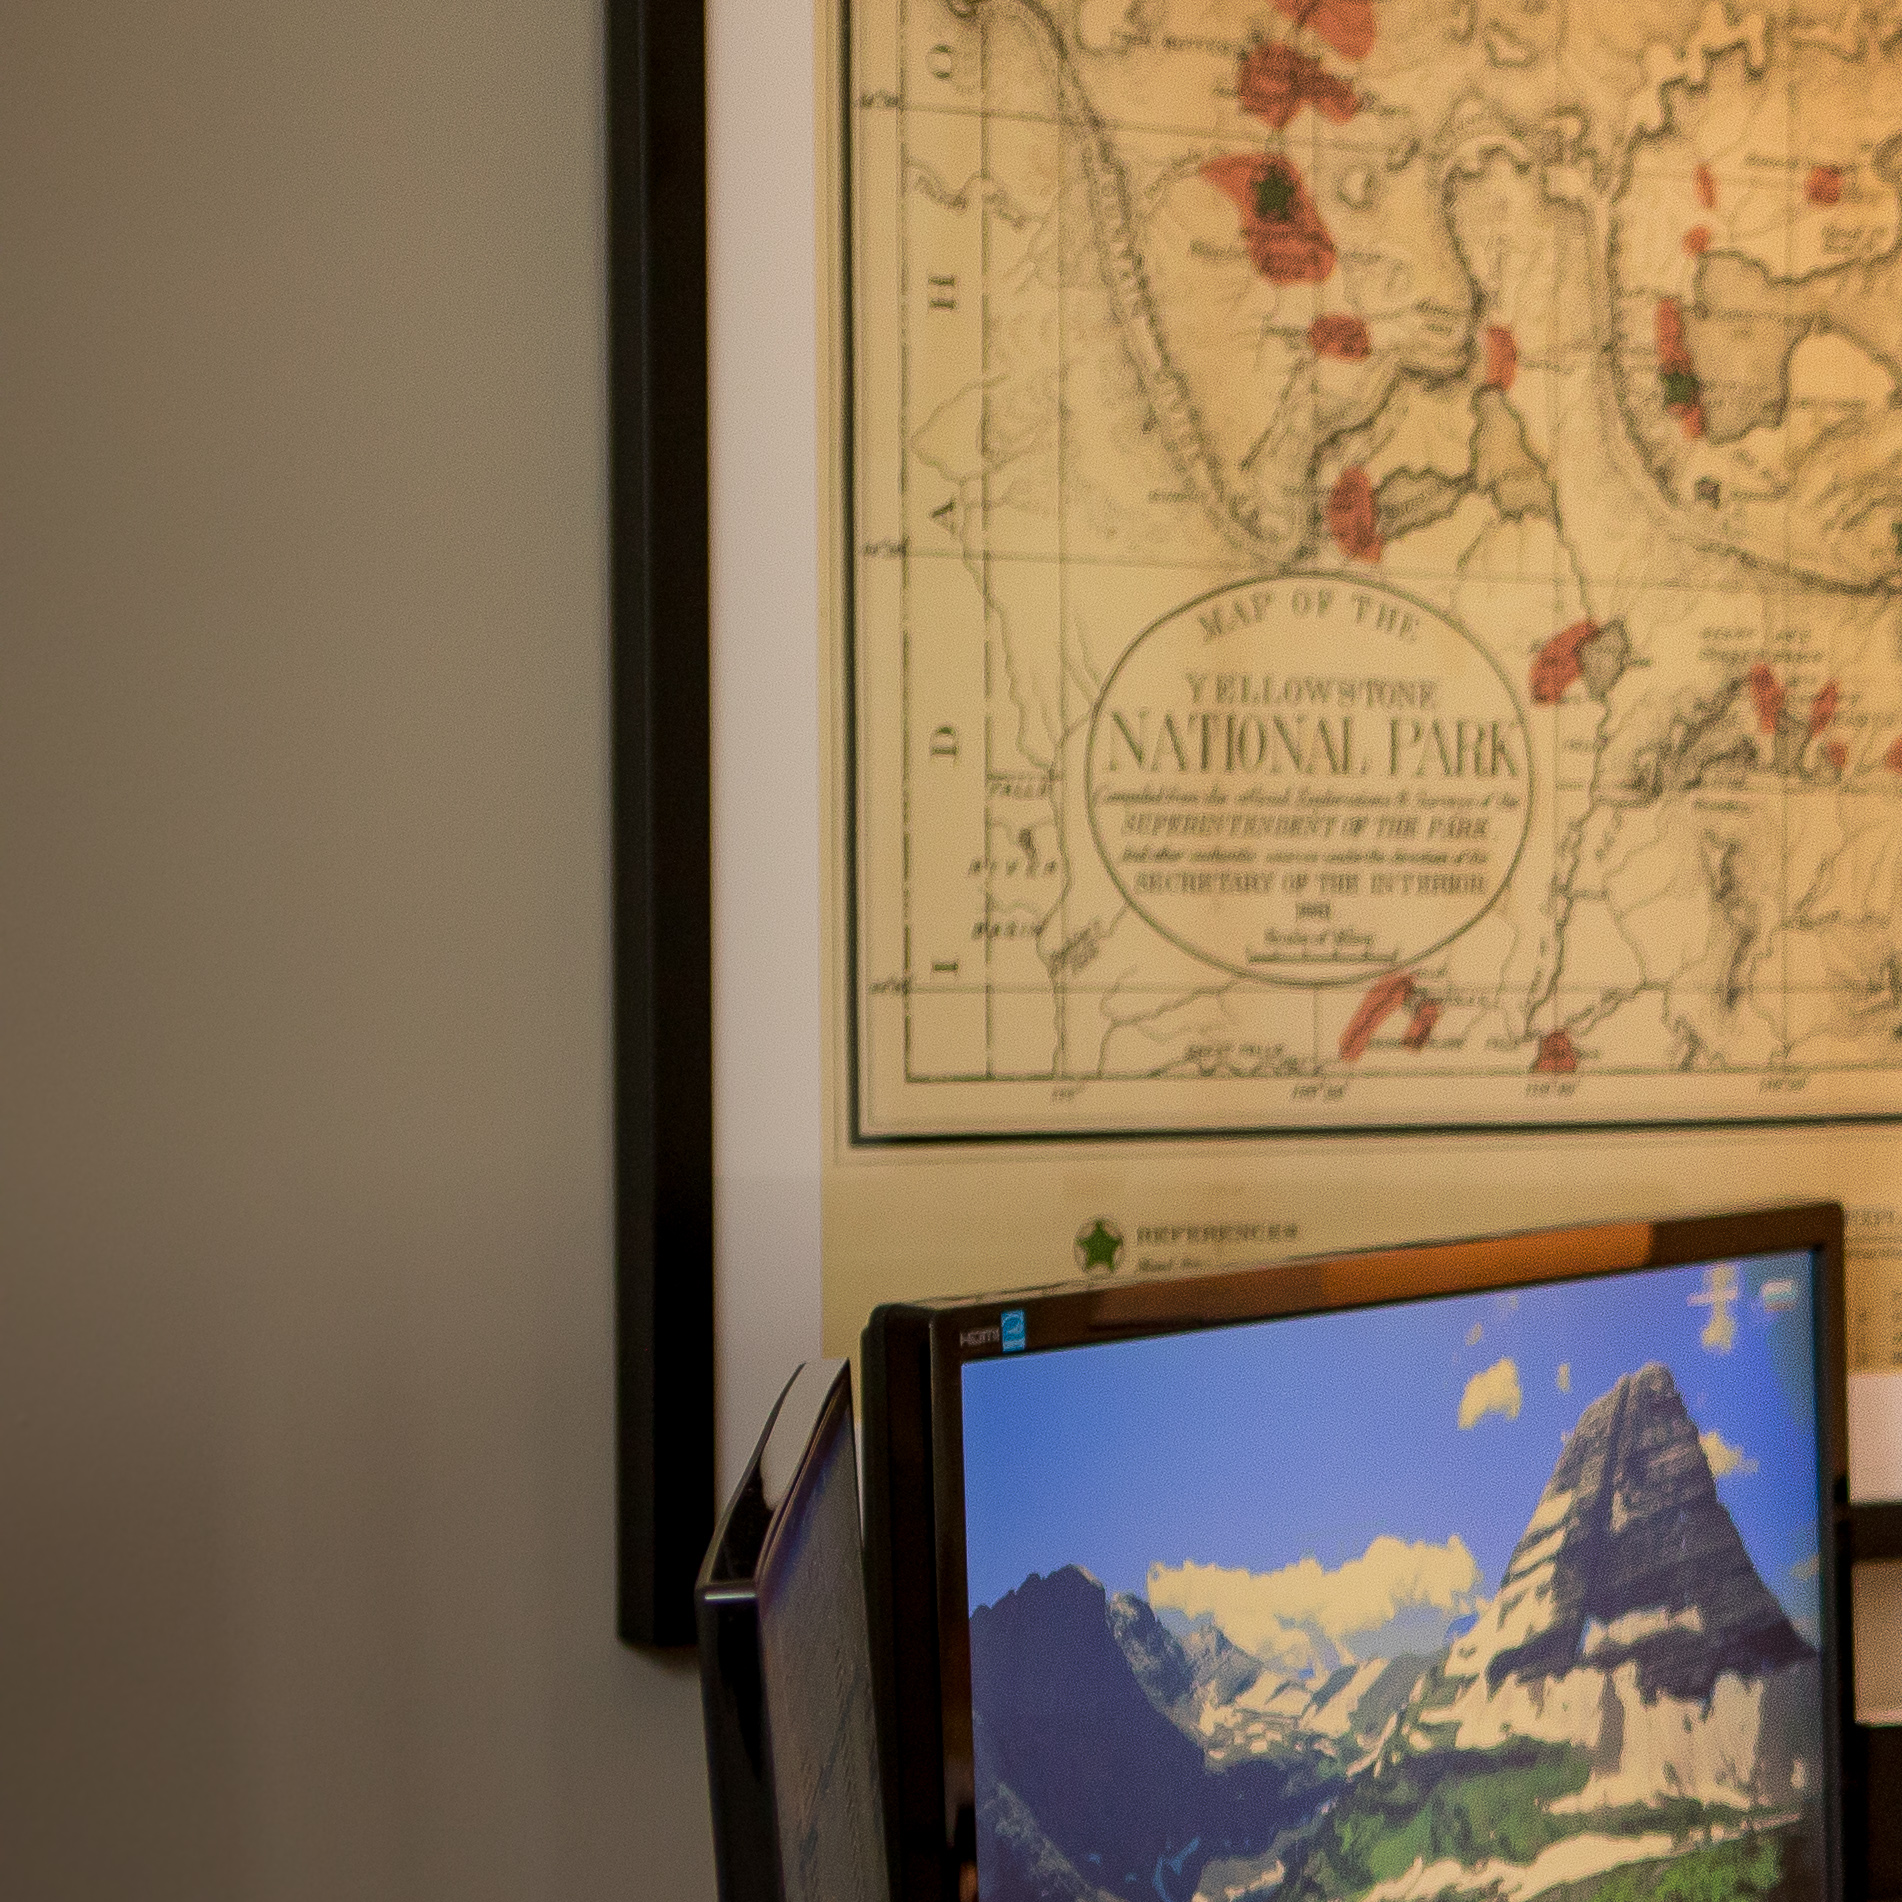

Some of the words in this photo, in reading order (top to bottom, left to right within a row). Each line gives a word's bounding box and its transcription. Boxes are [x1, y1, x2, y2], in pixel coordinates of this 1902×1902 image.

[1197, 590, 1273, 642] MAP
[1291, 588, 1335, 618] OF
[1351, 592, 1422, 643] THE
[1184, 672, 1441, 709] YELLOWSTONE
[1107, 709, 1367, 777] NATIONAL
[1386, 716, 1520, 778] PARK
[1122, 812, 1338, 837] SUPERINTENDENT
[1341, 815, 1369, 838] OF
[1374, 815, 1418, 838] THE
[1427, 815, 1489, 839] PARK
[1135, 872, 1276, 896] SECRETARY
[1282, 873, 1310, 896] OF
[1316, 873, 1359, 896] THE
[1370, 873, 1488, 896] INTERIOR
